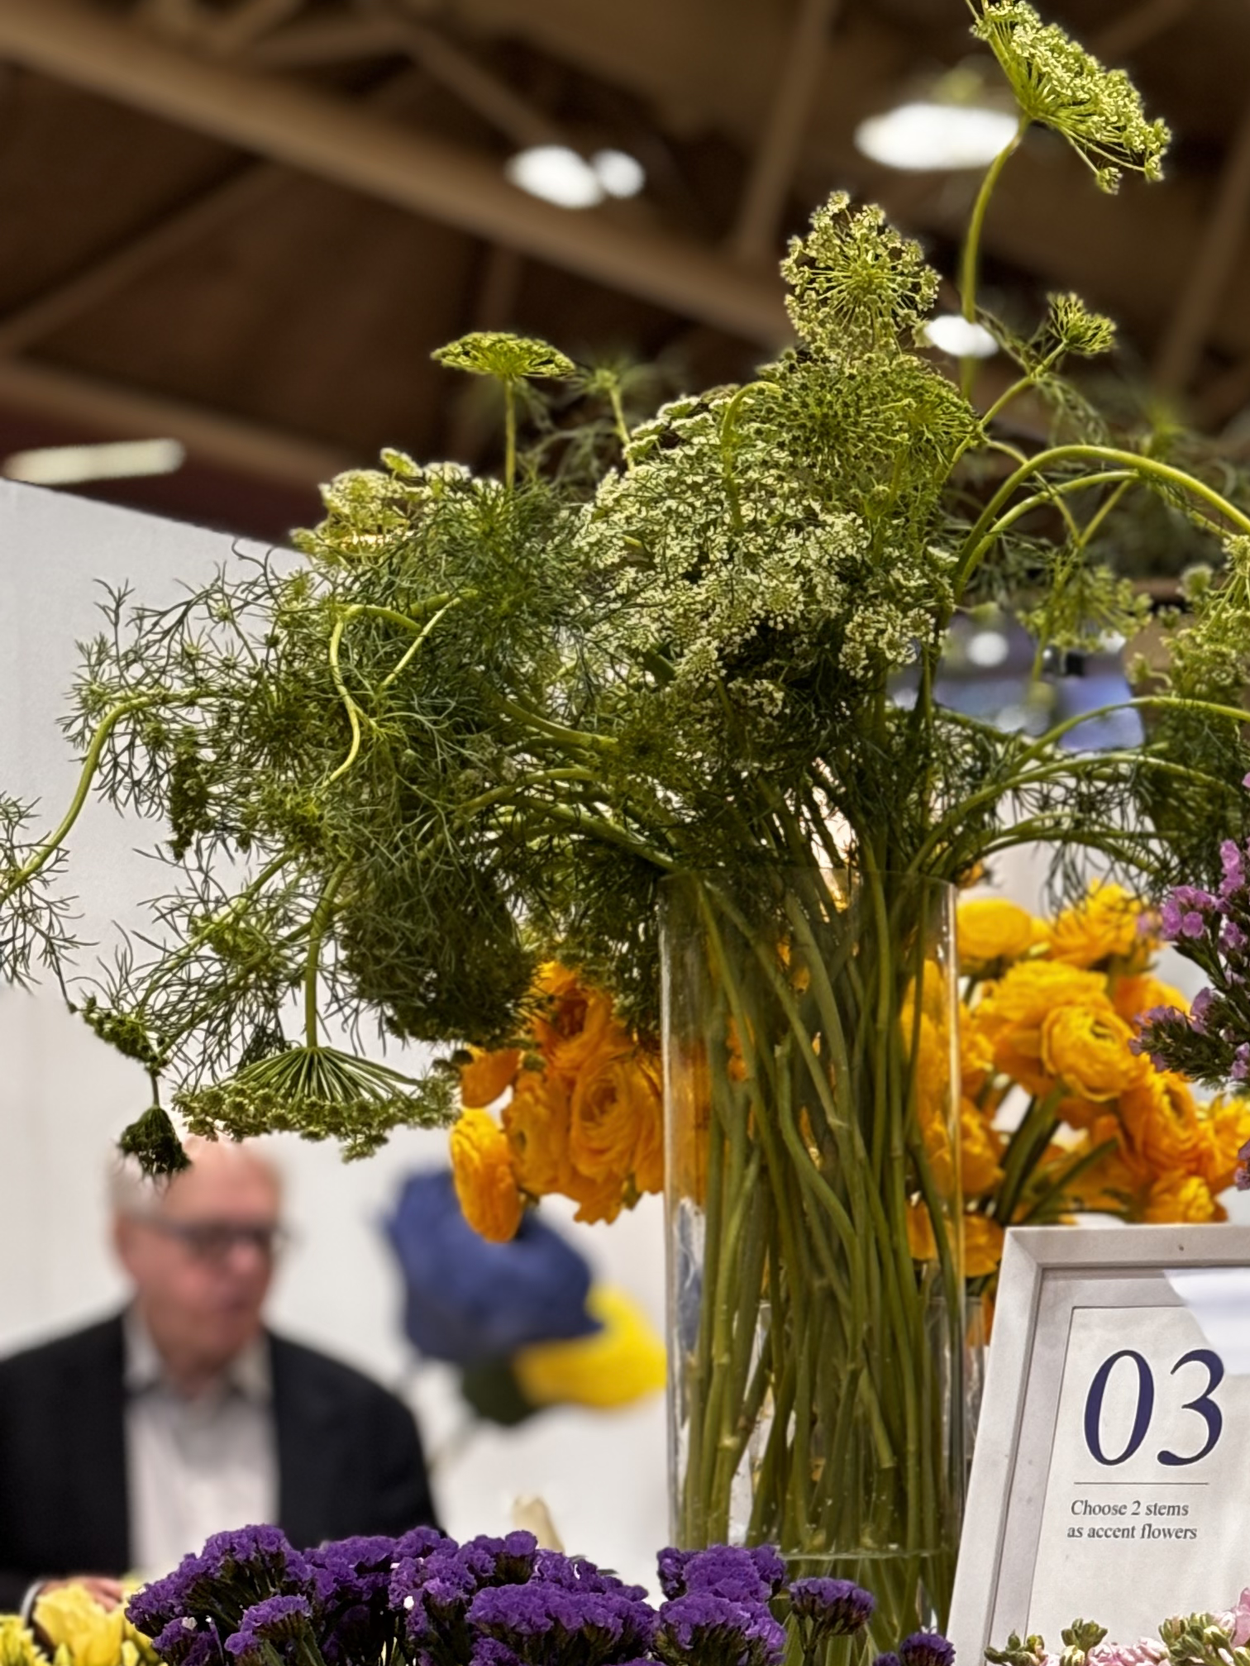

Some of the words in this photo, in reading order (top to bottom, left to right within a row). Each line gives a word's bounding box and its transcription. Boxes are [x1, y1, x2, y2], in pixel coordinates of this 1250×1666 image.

[1084, 1349, 1224, 1466] 03
[1070, 1499, 1128, 1516] Choose
[1131, 1500, 1142, 1516] 2
[1145, 1502, 1190, 1517] stems
[1067, 1525, 1084, 1539] as
[1087, 1525, 1136, 1539] accent
[1140, 1523, 1198, 1540] flowers
